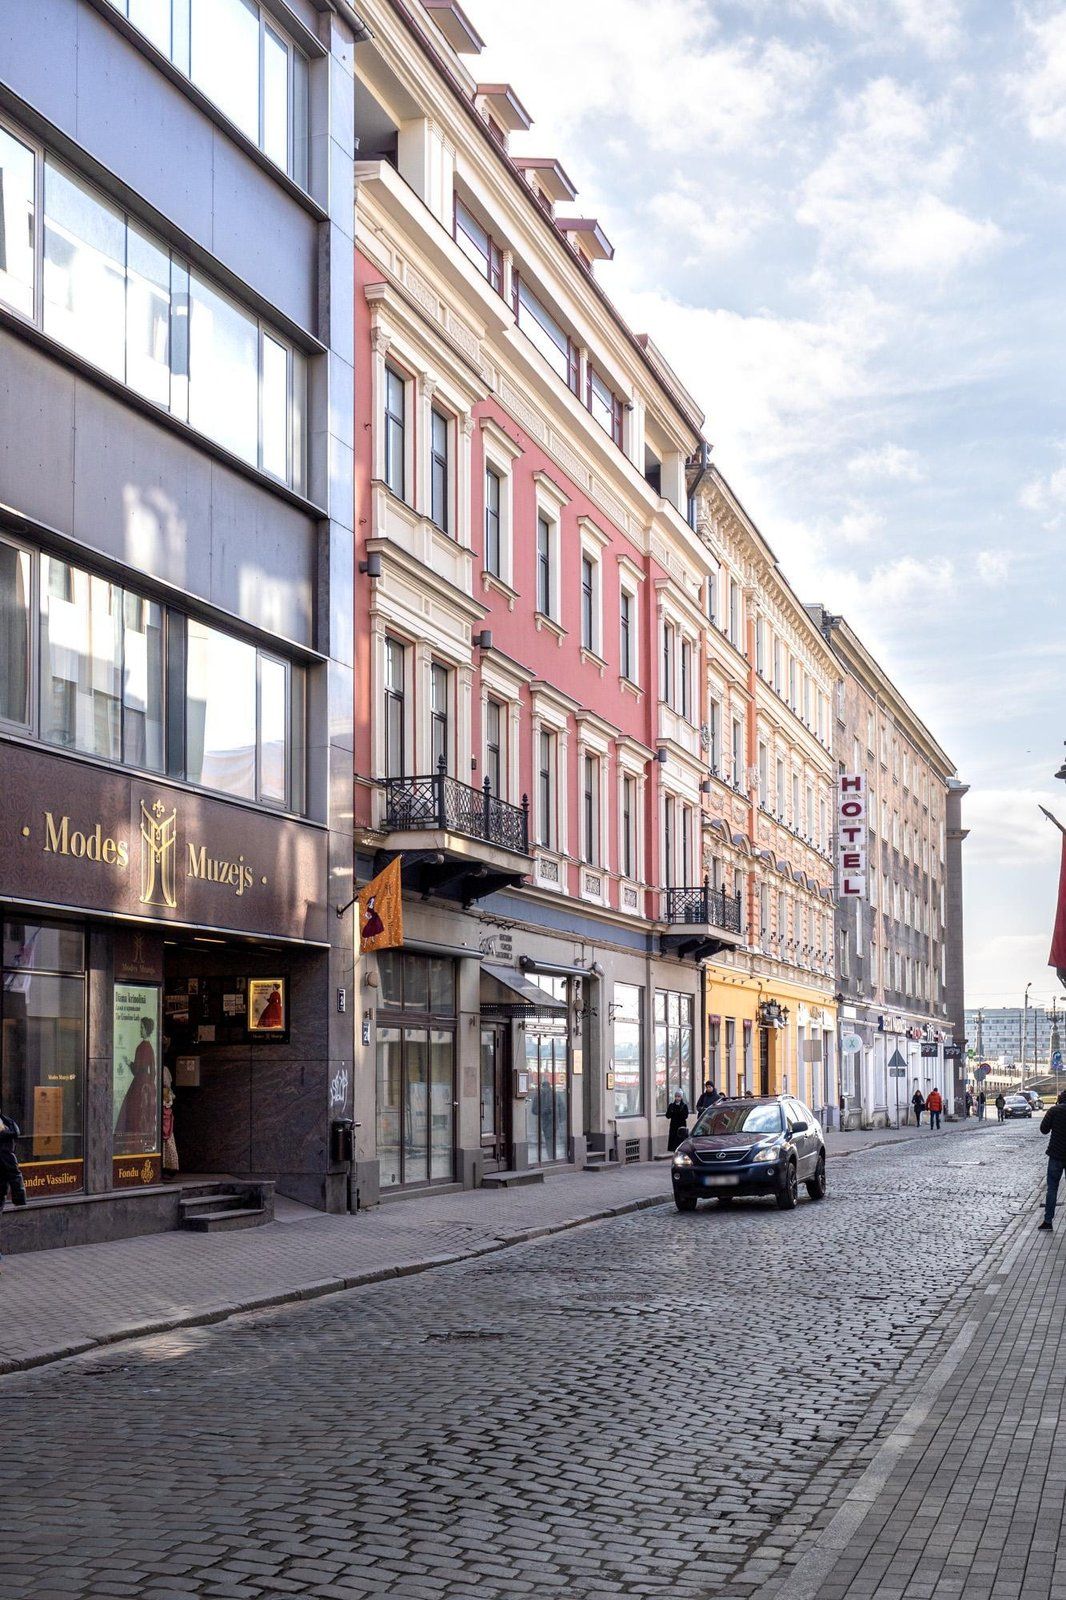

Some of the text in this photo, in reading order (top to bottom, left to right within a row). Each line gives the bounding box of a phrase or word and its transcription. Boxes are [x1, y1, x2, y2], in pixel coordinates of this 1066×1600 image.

[43, 811, 254, 897] Modes Muzejs
[841, 776, 862, 894] HOTEL
[24, 1175, 46, 1188] andre
[118, 1167, 139, 1179] Fondu
